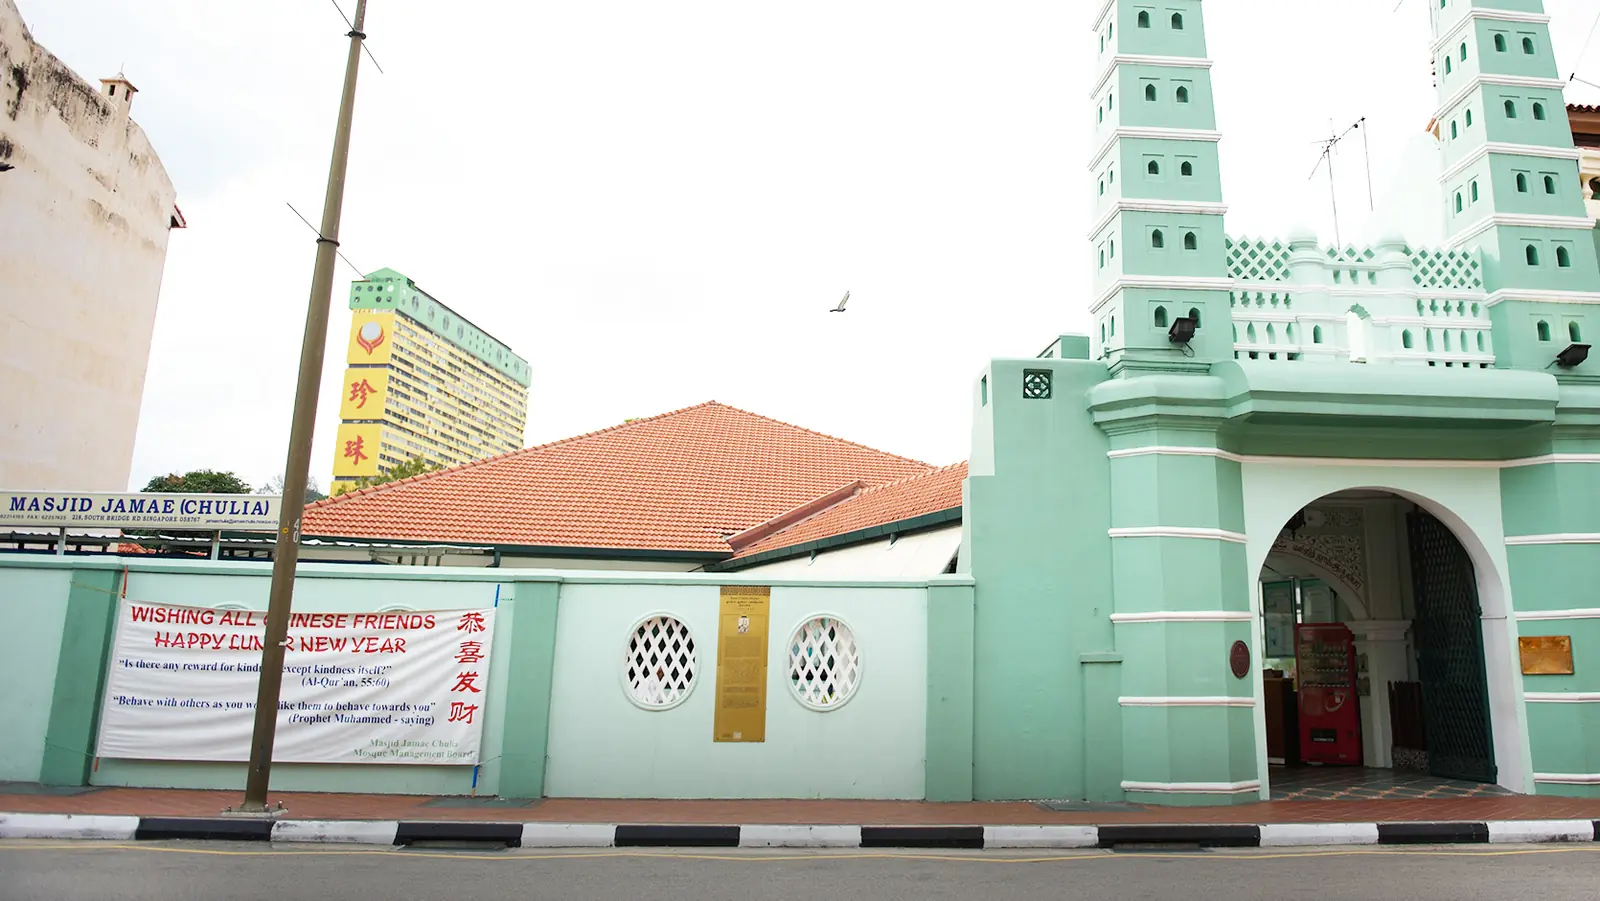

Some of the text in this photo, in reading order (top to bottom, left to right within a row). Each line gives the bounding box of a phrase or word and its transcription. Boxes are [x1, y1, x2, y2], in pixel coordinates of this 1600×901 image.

[344, 378, 378, 466] 珍珠
[9, 496, 269, 516] MASJID JAMAE (CHULIA)
[131, 605, 436, 630] WISHING ALL INESE FRIENDS
[154, 631, 407, 654] HAPPY LUNR NEW YEAR
[135, 659, 161, 670] there
[162, 662, 181, 673] any
[182, 661, 217, 672] reward
[219, 661, 235, 672] for
[281, 666, 311, 677] except
[313, 664, 356, 675] kindness
[447, 611, 486, 725] 恭喜发财
[156, 696, 178, 708] with
[179, 697, 211, 709] others
[212, 700, 223, 709] as
[224, 700, 243, 712] you
[297, 701, 322, 711] them
[323, 701, 334, 711] to
[335, 701, 371, 712] behave
[372, 701, 411, 712] towards
[288, 714, 332, 726] (Prophet
[333, 714, 393, 725] Muhammed
[400, 714, 435, 727] saying)
[370, 740, 400, 750] Masjid
[400, 739, 430, 749] Jamae
[353, 749, 474, 760] Mosque Management Board
